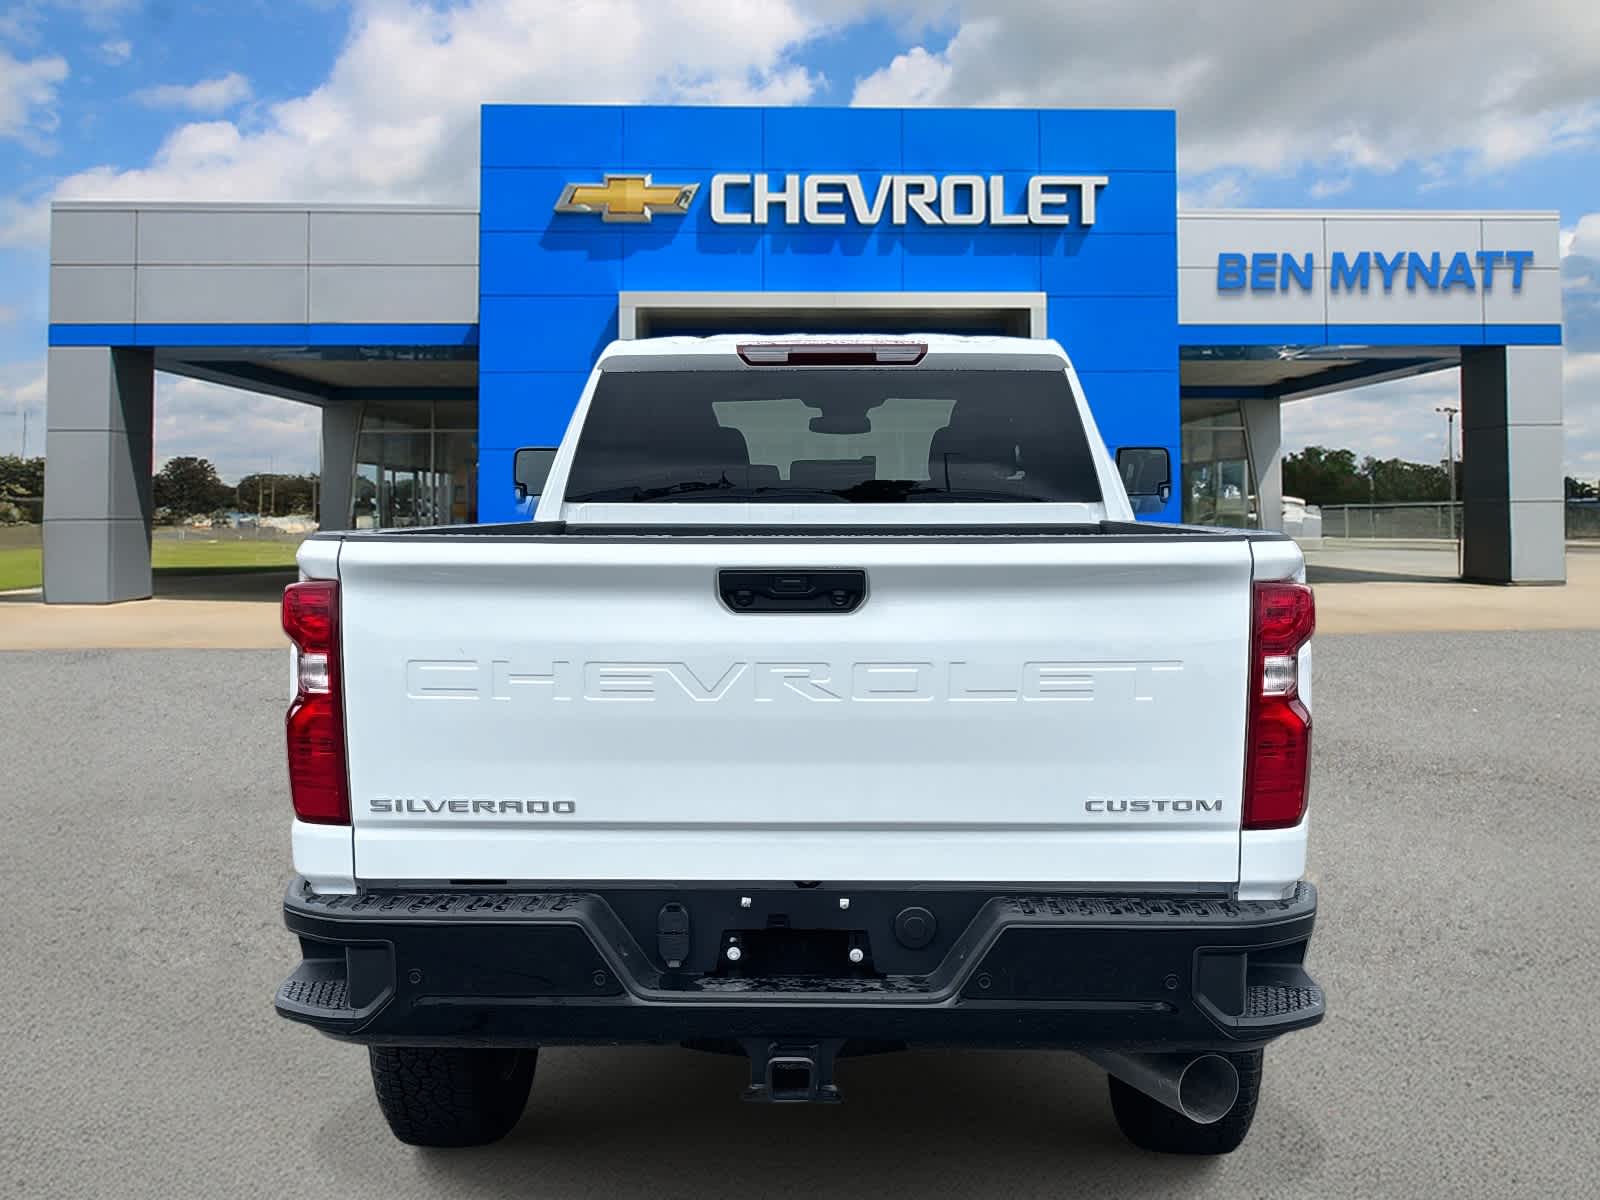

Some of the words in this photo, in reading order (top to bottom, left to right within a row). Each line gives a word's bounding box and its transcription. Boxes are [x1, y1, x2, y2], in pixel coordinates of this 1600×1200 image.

[710, 173, 1109, 225] CHEVROLET
[1217, 252, 1313, 290] BEN
[1330, 250, 1534, 290] MYNATT
[406, 659, 1184, 702] CHEVROLET
[369, 799, 577, 814] SILVERADO
[1085, 799, 1223, 812] CUSTOM
